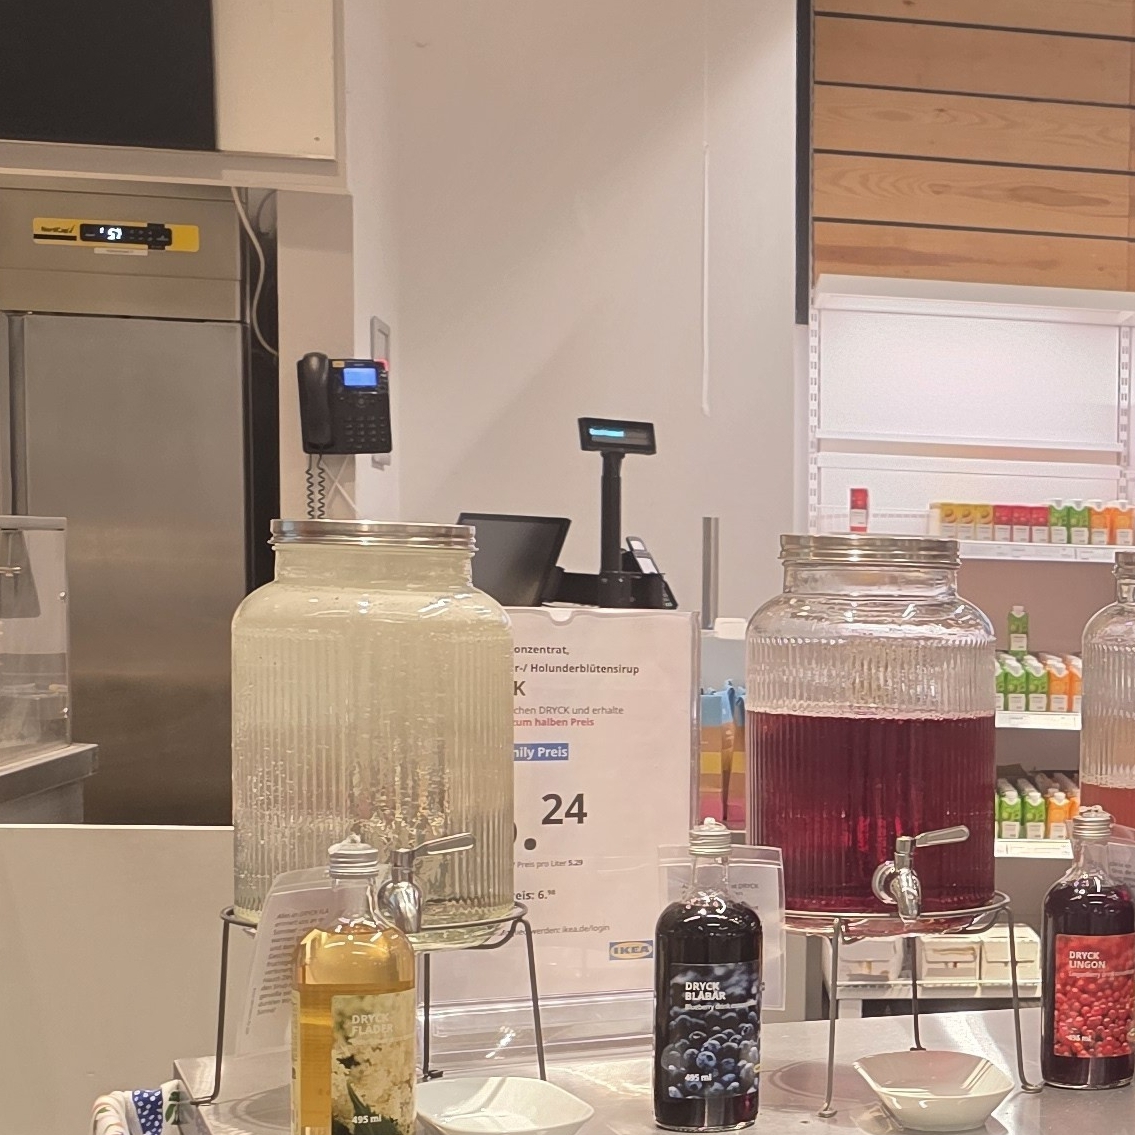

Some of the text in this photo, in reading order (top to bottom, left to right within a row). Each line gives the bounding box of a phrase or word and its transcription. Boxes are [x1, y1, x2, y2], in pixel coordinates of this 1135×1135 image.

[514, 646, 570, 656] onzentrat,
[530, 663, 640, 677] Holunderblütensirup
[513, 680, 526, 697] K
[513, 706, 624, 715] chen DRYCK und erhalte
[534, 718, 568, 727] halben
[570, 718, 595, 727] Preis
[537, 746, 568, 758] Preis
[514, 890, 535, 900] eis:
[612, 944, 651, 956] IKEA
[1069, 950, 1100, 960] DRYCK
[1069, 960, 1106, 969] LINGON
[684, 981, 720, 991] DRYCK
[684, 990, 726, 1001] BLÅBÄR
[352, 1012, 390, 1024] DRYCK
[352, 1114, 382, 1124] 495 ml
